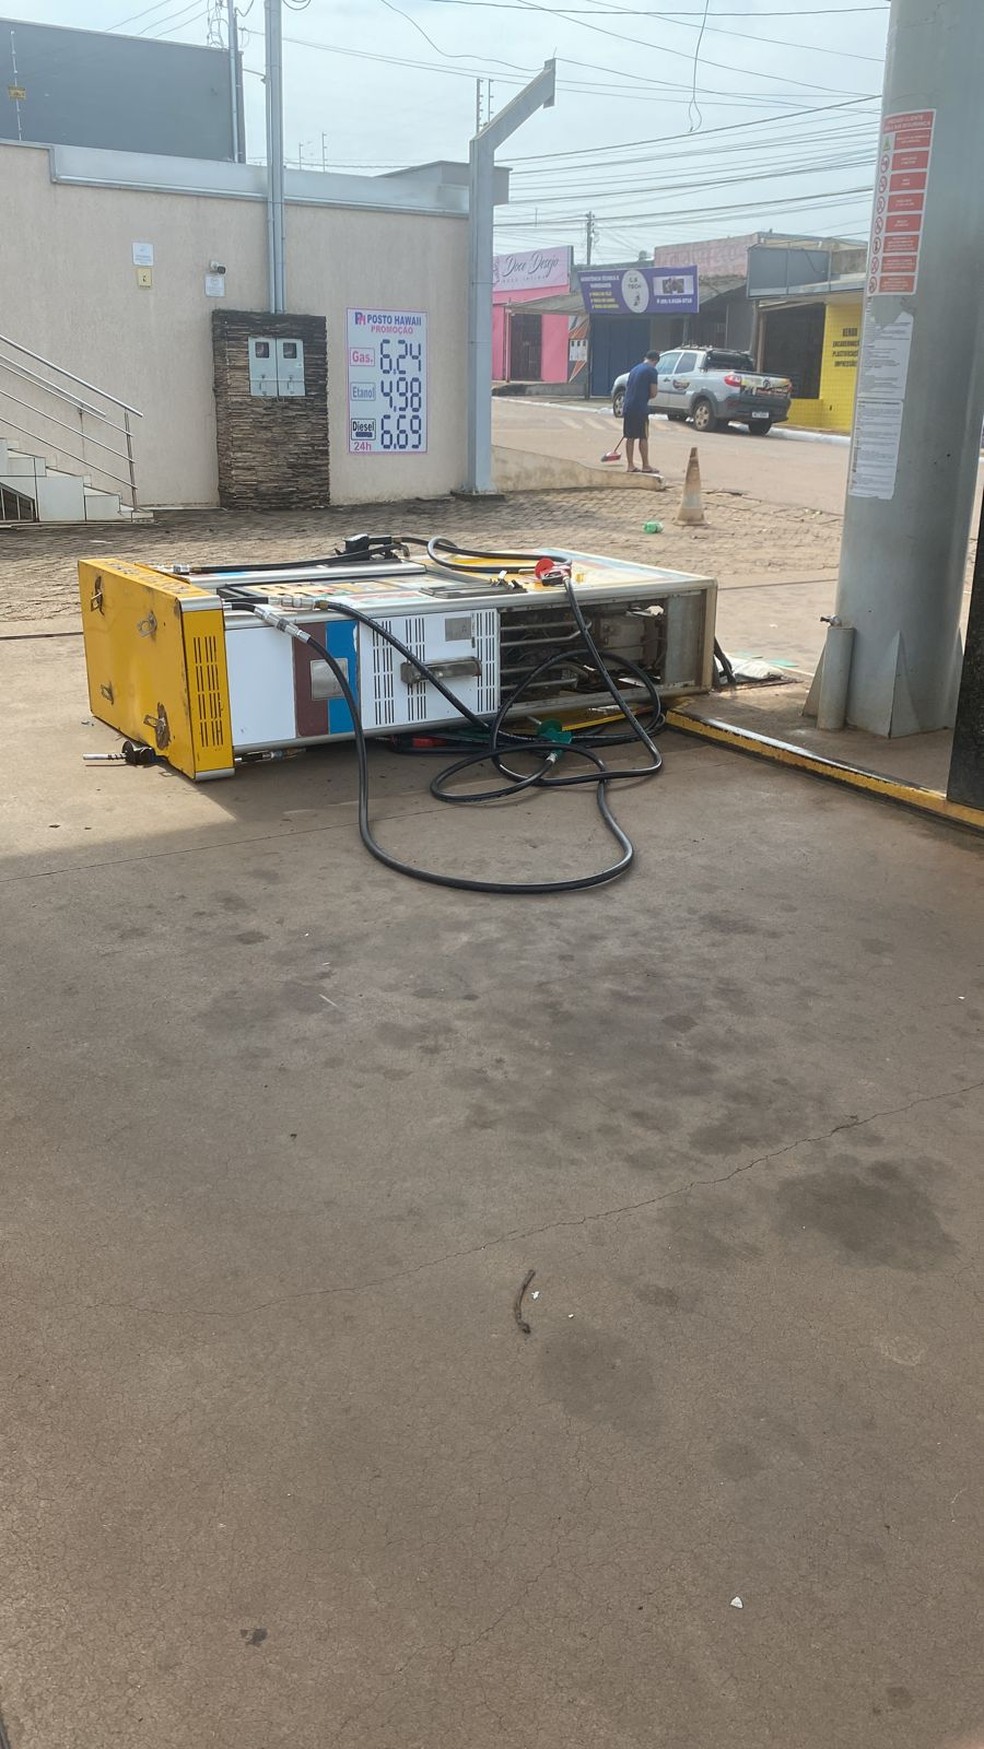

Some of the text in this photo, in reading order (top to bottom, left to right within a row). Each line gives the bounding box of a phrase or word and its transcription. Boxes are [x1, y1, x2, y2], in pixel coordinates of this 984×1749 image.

[367, 314, 392, 325] POSTO
[394, 316, 422, 326] HAWAII
[352, 351, 374, 363] Gas.
[352, 386, 375, 398] Etanol
[352, 420, 375, 431] Diesel
[354, 442, 372, 451] 24h
